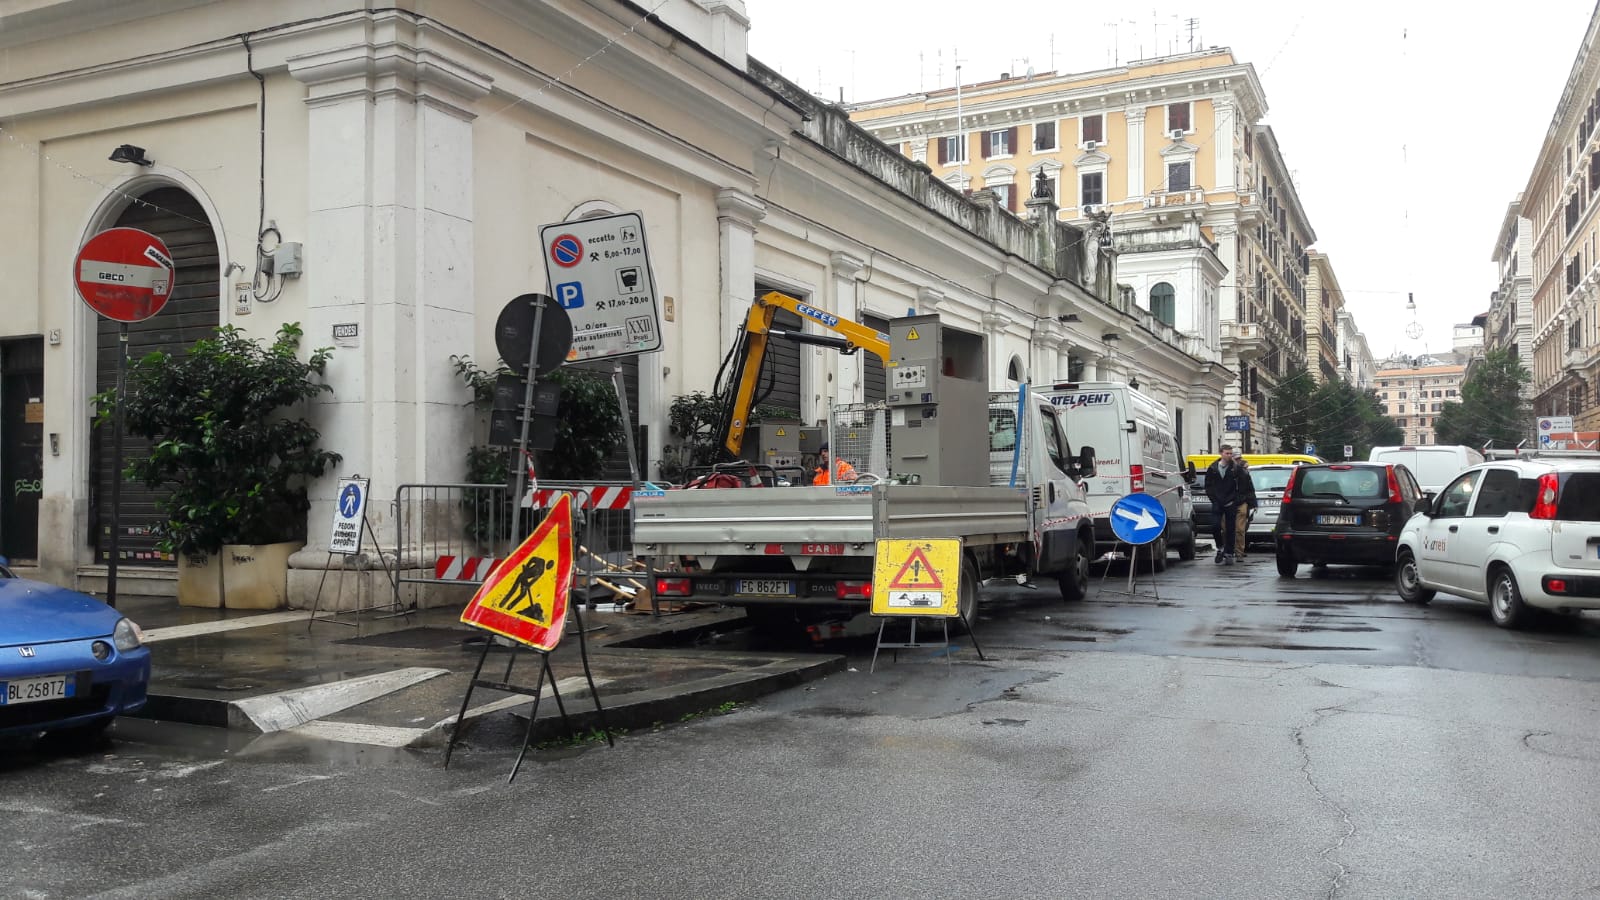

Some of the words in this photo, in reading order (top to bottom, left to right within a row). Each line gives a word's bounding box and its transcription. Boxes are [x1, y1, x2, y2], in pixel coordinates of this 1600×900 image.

[588, 234, 615, 244] eccetto
[562, 286, 577, 306] P
[608, 297, 648, 307] 17,00-20,00
[799, 304, 837, 326] EFFER
[335, 326, 357, 337] VENDESI
[628, 319, 651, 334] XXII
[1049, 395, 1076, 406] ATEL
[1078, 394, 1111, 407] RENT
[757, 581, 789, 593] 862FT
[9, 685, 23, 700] BL
[27, 680, 64, 699] 258TZ
